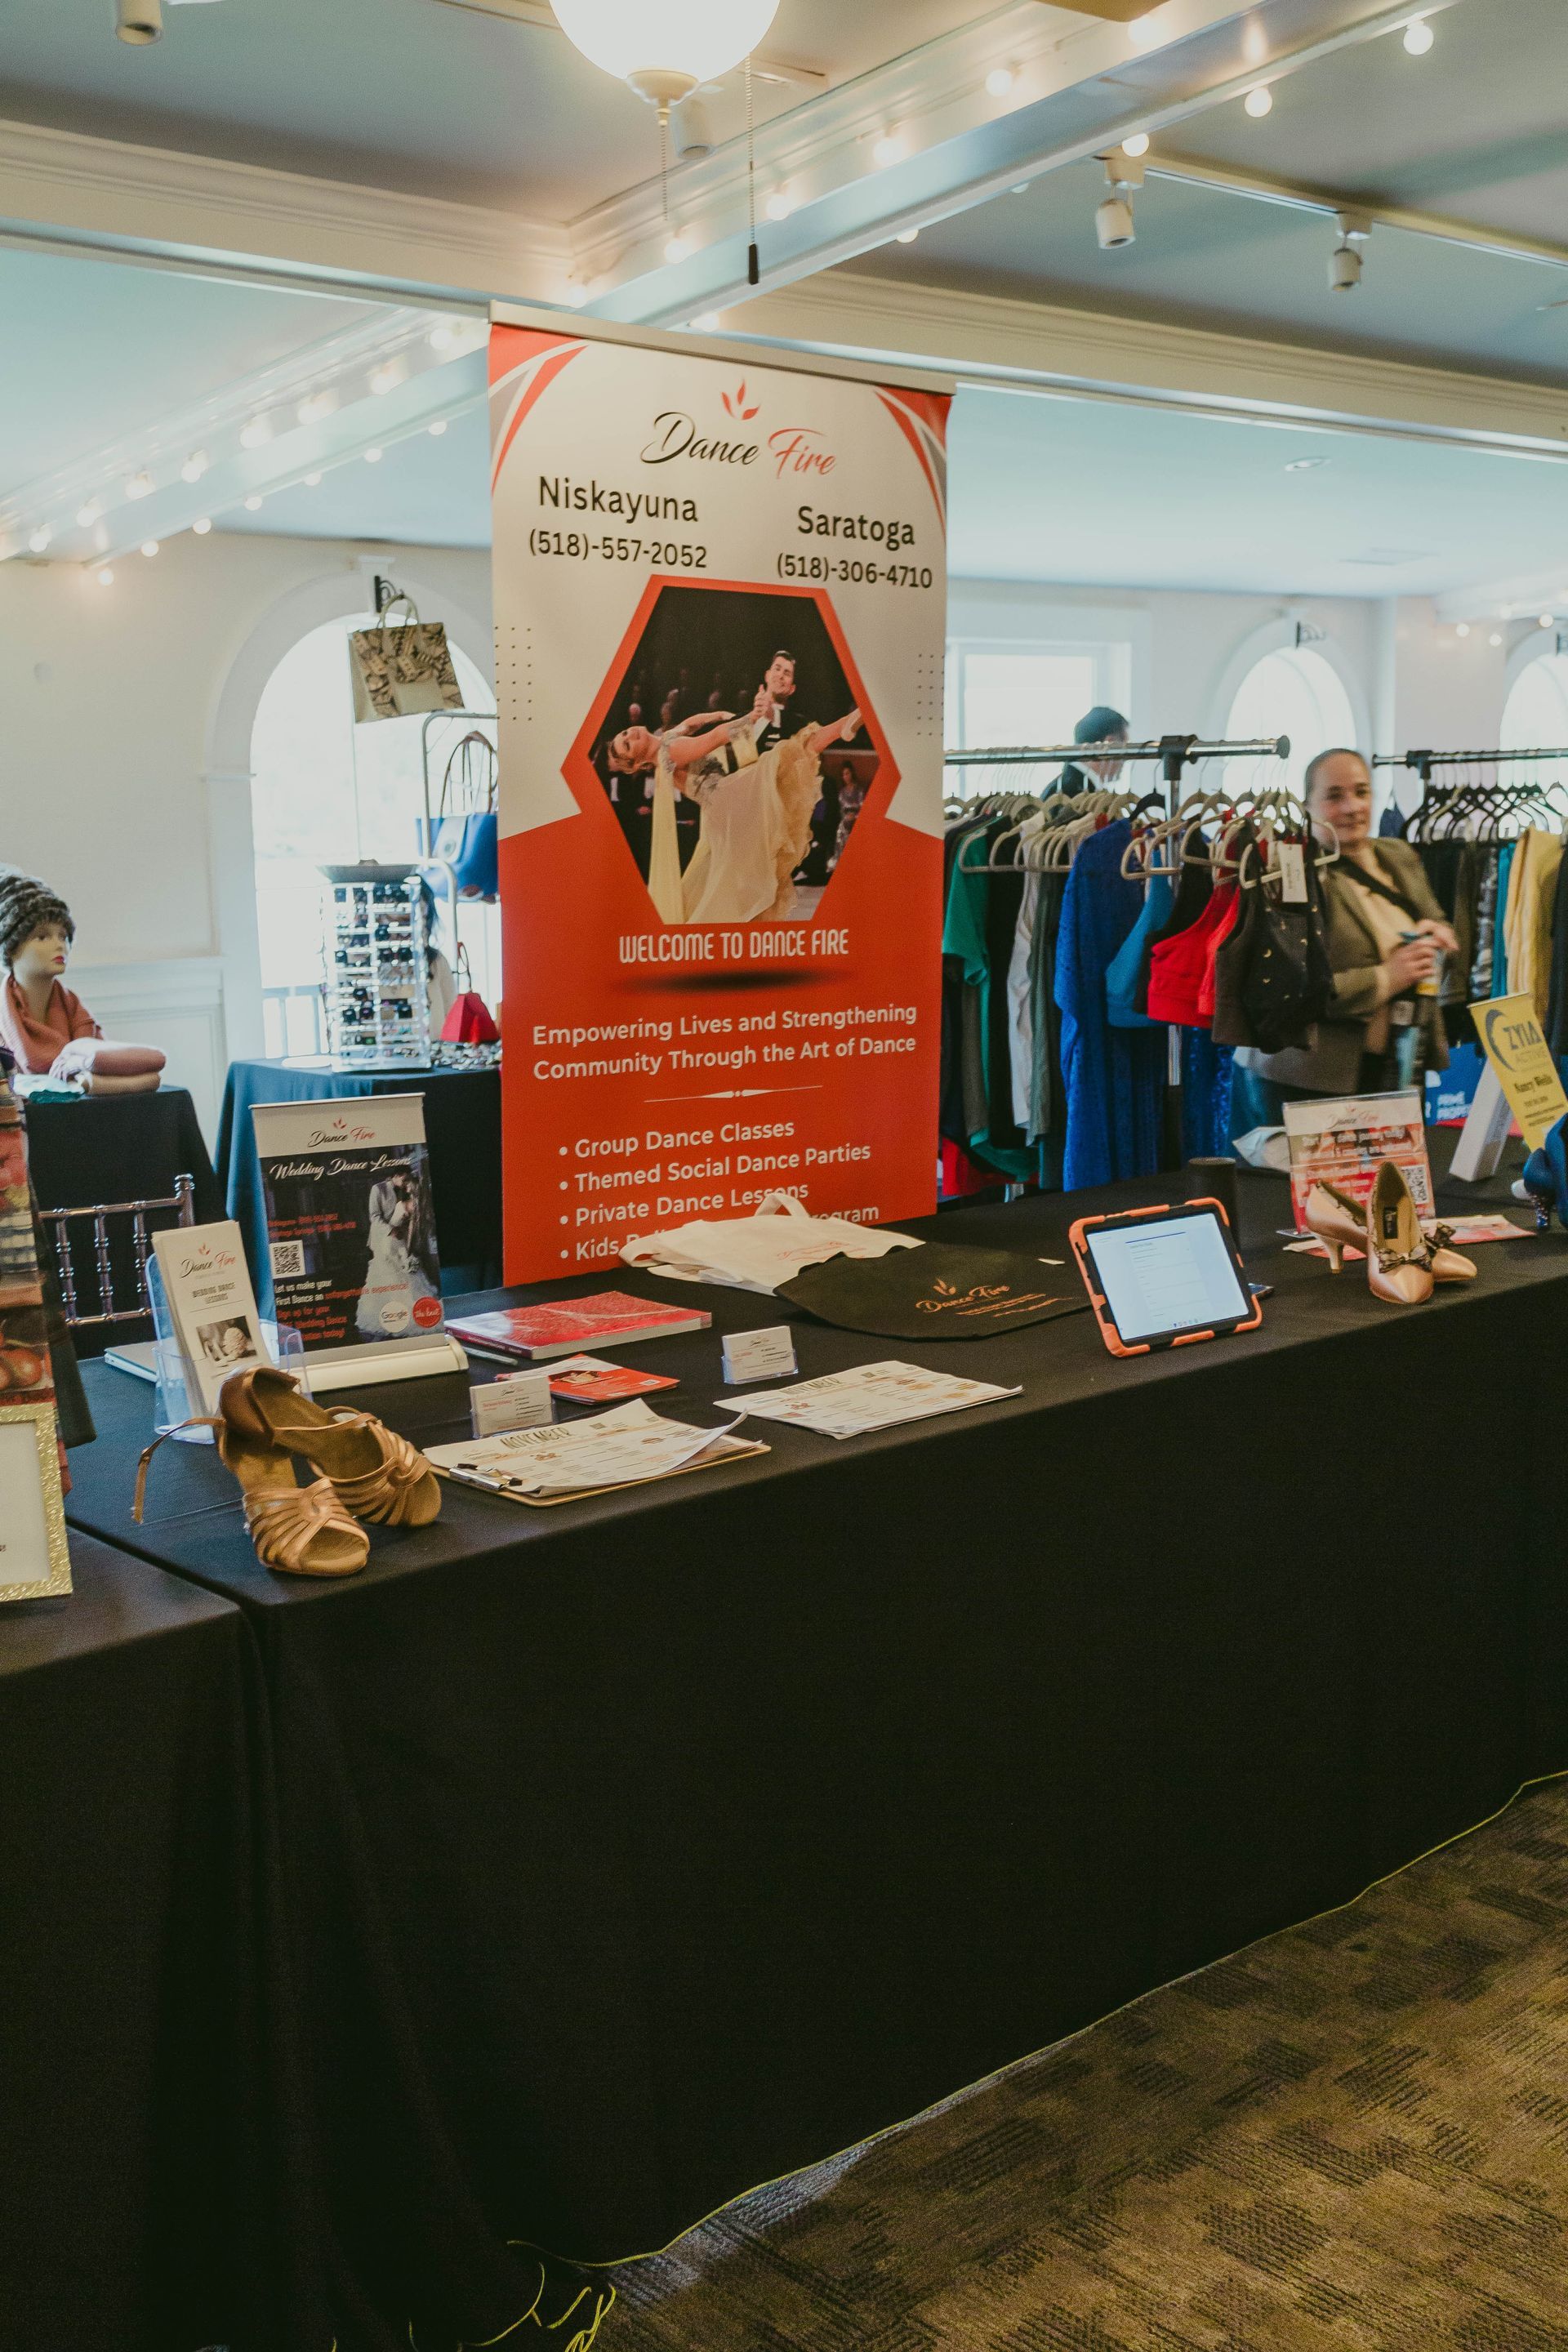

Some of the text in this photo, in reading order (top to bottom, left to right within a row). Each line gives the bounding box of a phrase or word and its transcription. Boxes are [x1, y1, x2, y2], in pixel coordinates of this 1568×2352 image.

[640, 411, 838, 480] Dance Fire
[537, 475, 700, 525] Niskayuna
[797, 505, 916, 553] Saratoga
[529, 528, 708, 570] (518)-557-2052
[777, 552, 933, 590] (518)-306-4710
[619, 929, 850, 964] WELCOME TO DANCE FIRE
[532, 1004, 918, 1048] Empowering Lives and Strengthening
[533, 1035, 916, 1080] Community Through the Art of Dance
[307, 1126, 376, 1147] Dance Fire
[575, 1120, 795, 1159] Group Dance Classes
[270, 1161, 326, 1181] Wedding
[327, 1157, 368, 1176] Dance
[575, 1143, 871, 1193] Themed Social Dance Parties
[576, 1200, 650, 1227] Private
[656, 1193, 724, 1216] Dance
[576, 1236, 620, 1262] Kids
[180, 1258, 213, 1280] Dance
[381, 1310, 408, 1320] Google
[915, 1295, 974, 1313] Dance
[500, 1426, 572, 1450] NOVEMBER
